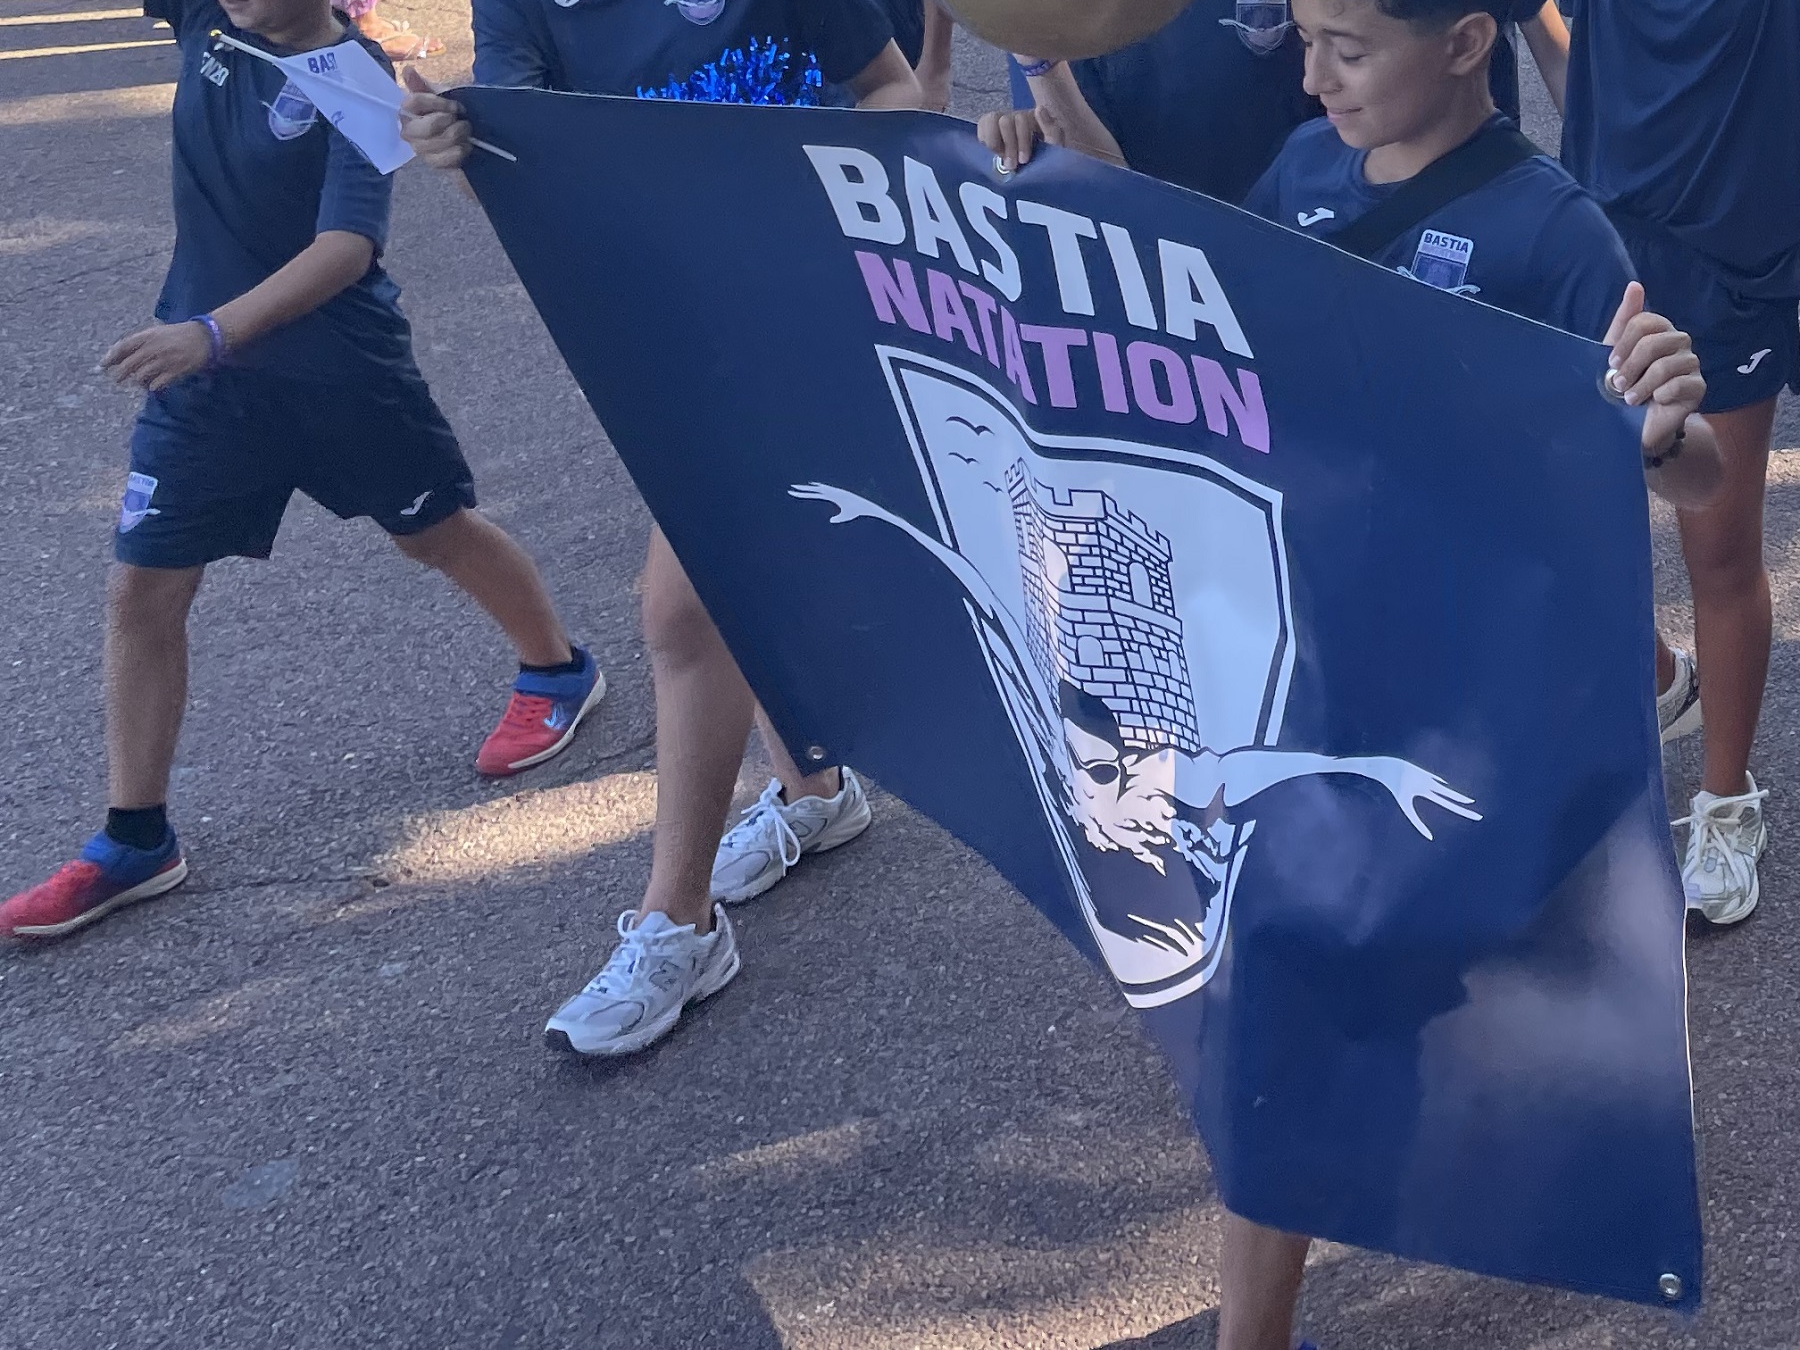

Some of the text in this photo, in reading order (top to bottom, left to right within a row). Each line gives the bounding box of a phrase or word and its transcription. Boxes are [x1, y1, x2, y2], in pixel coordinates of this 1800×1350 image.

[803, 144, 1255, 359] BASTIA
[1424, 232, 1469, 254] BASTIA
[854, 250, 1271, 455] NATATION
